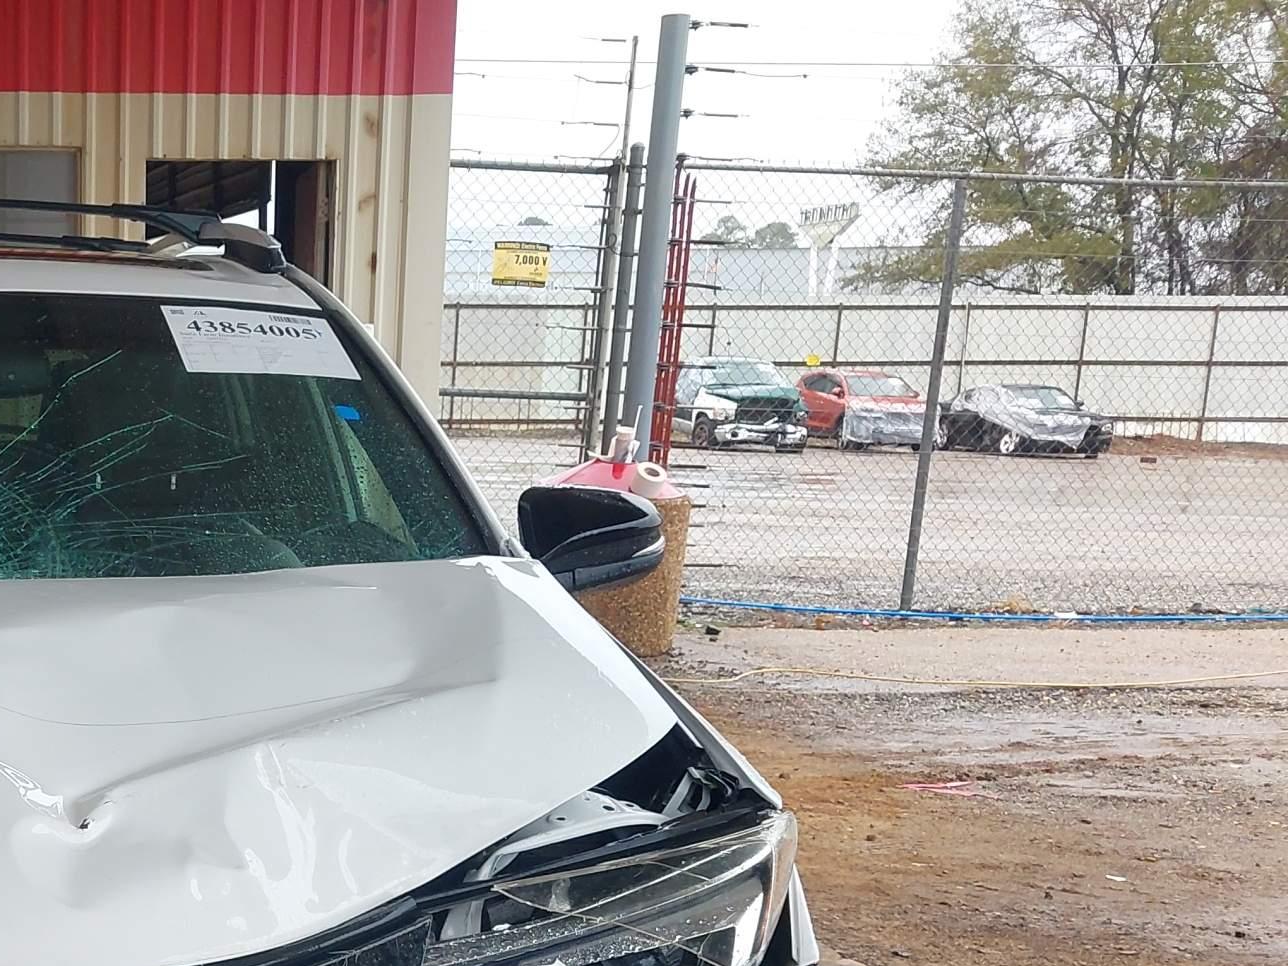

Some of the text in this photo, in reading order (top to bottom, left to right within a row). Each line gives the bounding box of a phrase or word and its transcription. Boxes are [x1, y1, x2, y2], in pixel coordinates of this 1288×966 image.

[514, 254, 548, 267] 7,000 V
[186, 319, 318, 340] 43854005
